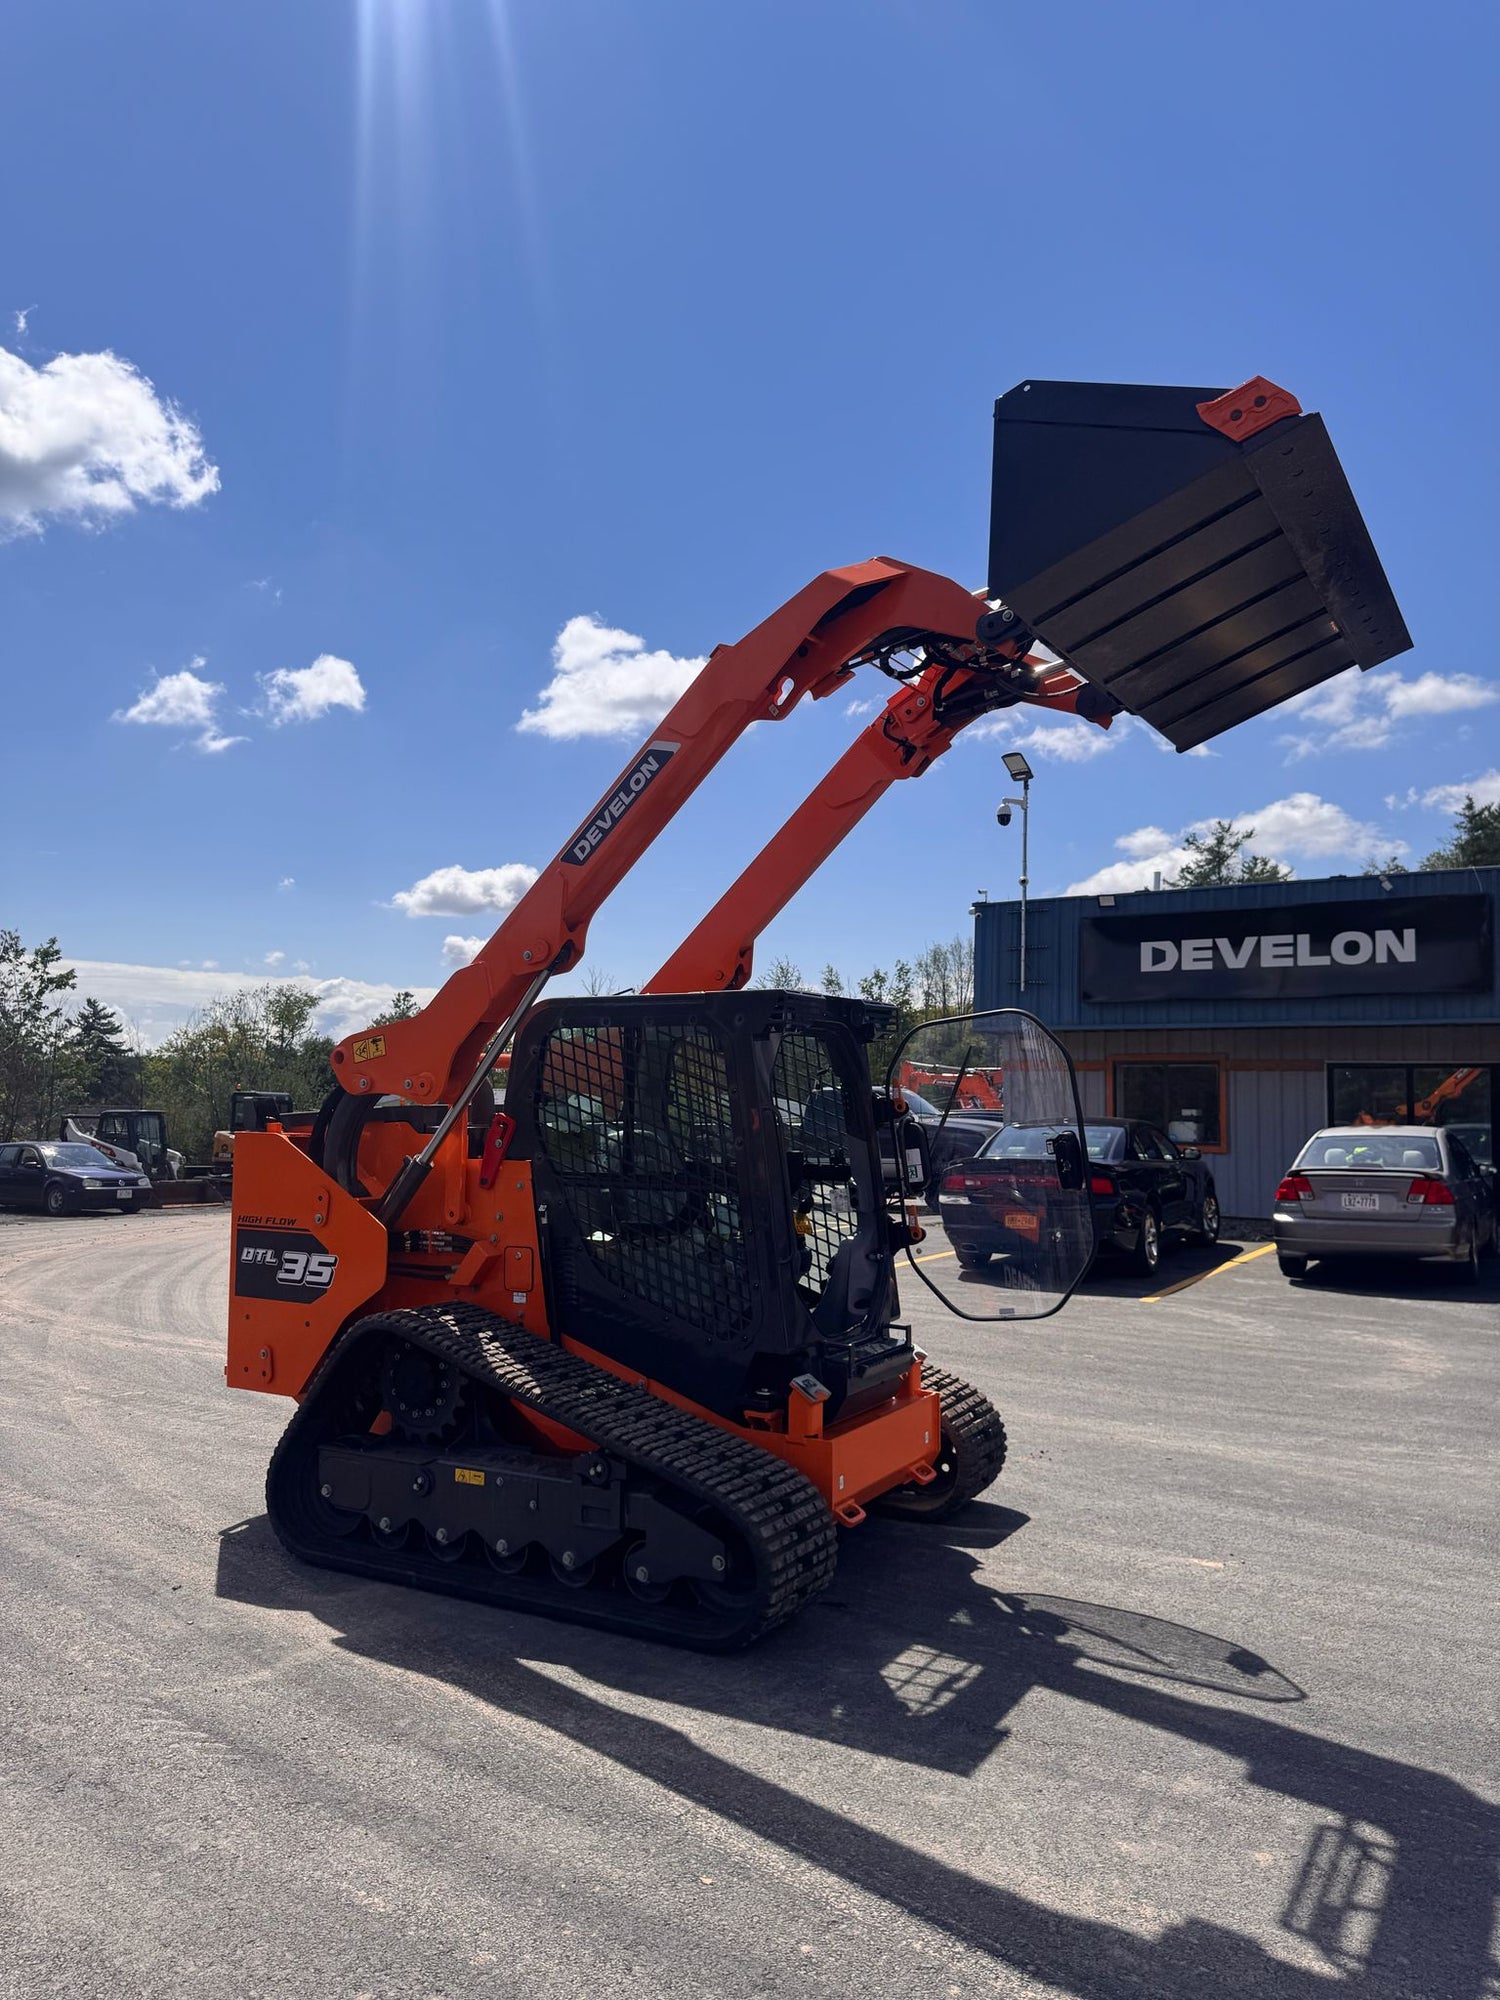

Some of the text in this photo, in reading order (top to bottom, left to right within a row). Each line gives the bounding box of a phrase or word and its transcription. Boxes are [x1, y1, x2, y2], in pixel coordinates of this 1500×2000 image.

[573, 756, 660, 861] DEVELON
[1140, 928, 1416, 972] DEVELON
[237, 1215, 297, 1226] HIGH FLOW
[241, 1247, 339, 1288] DTL 35
